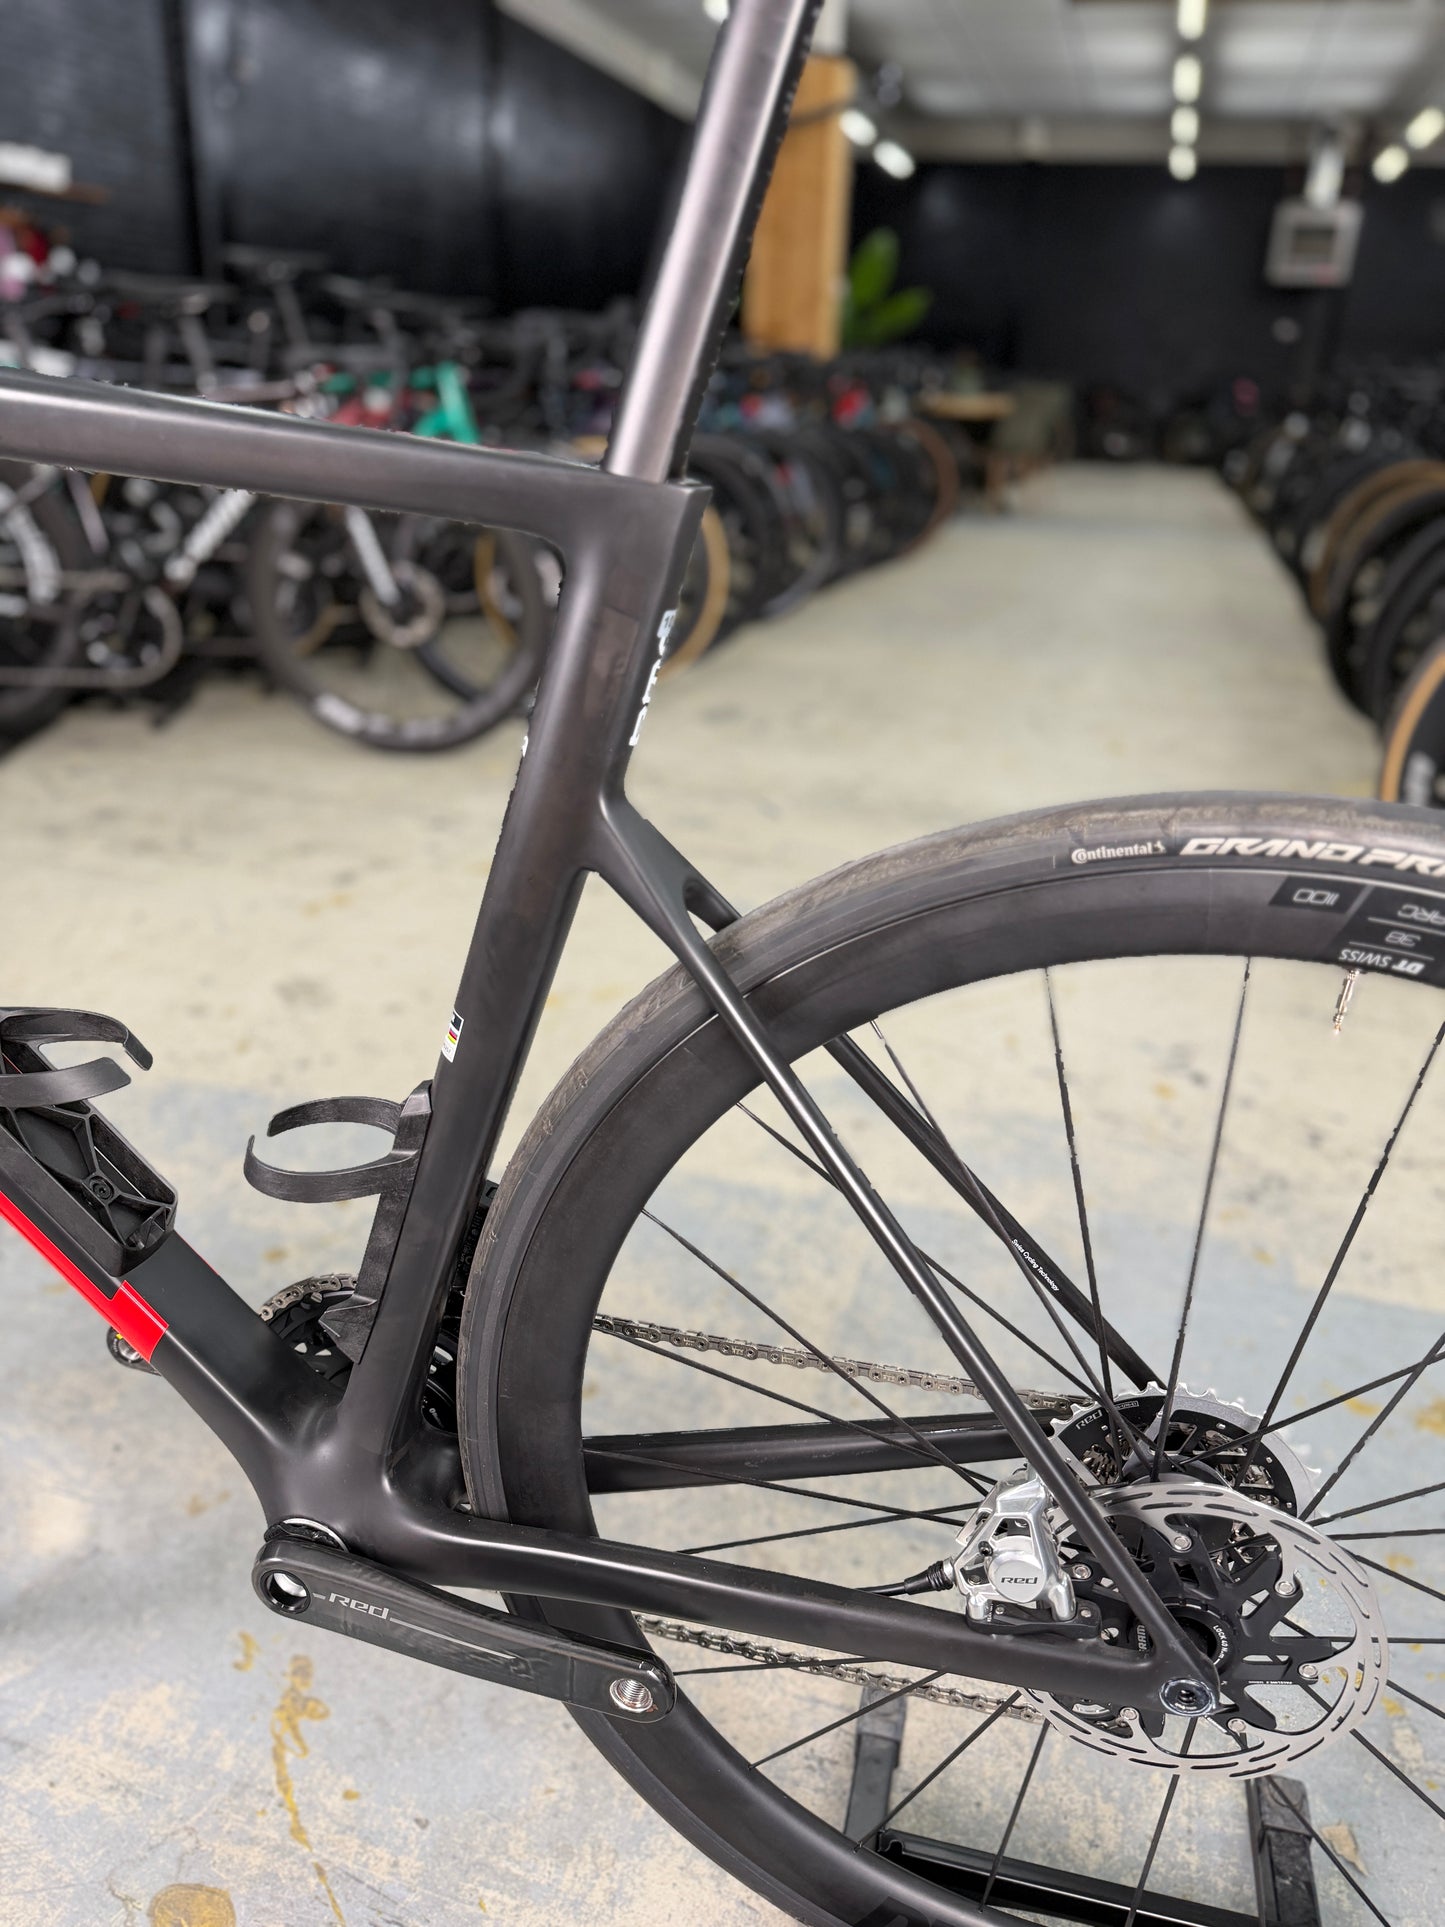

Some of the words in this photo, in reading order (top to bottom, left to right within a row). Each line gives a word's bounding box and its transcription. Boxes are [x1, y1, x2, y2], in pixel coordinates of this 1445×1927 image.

[1071, 842, 1153, 865] Continental
[1178, 837, 1365, 862] GRAND
[1384, 931, 1421, 948] 38
[1338, 949, 1393, 969] SWISS
[1391, 959, 1426, 976] DT
[1011, 1239, 1025, 1253] Swiss
[1023, 1251, 1039, 1269] Cycling
[1037, 1266, 1060, 1291] Technology
[1136, 1624, 1148, 1652] RAM
[1213, 1624, 1228, 1641] LOCK
